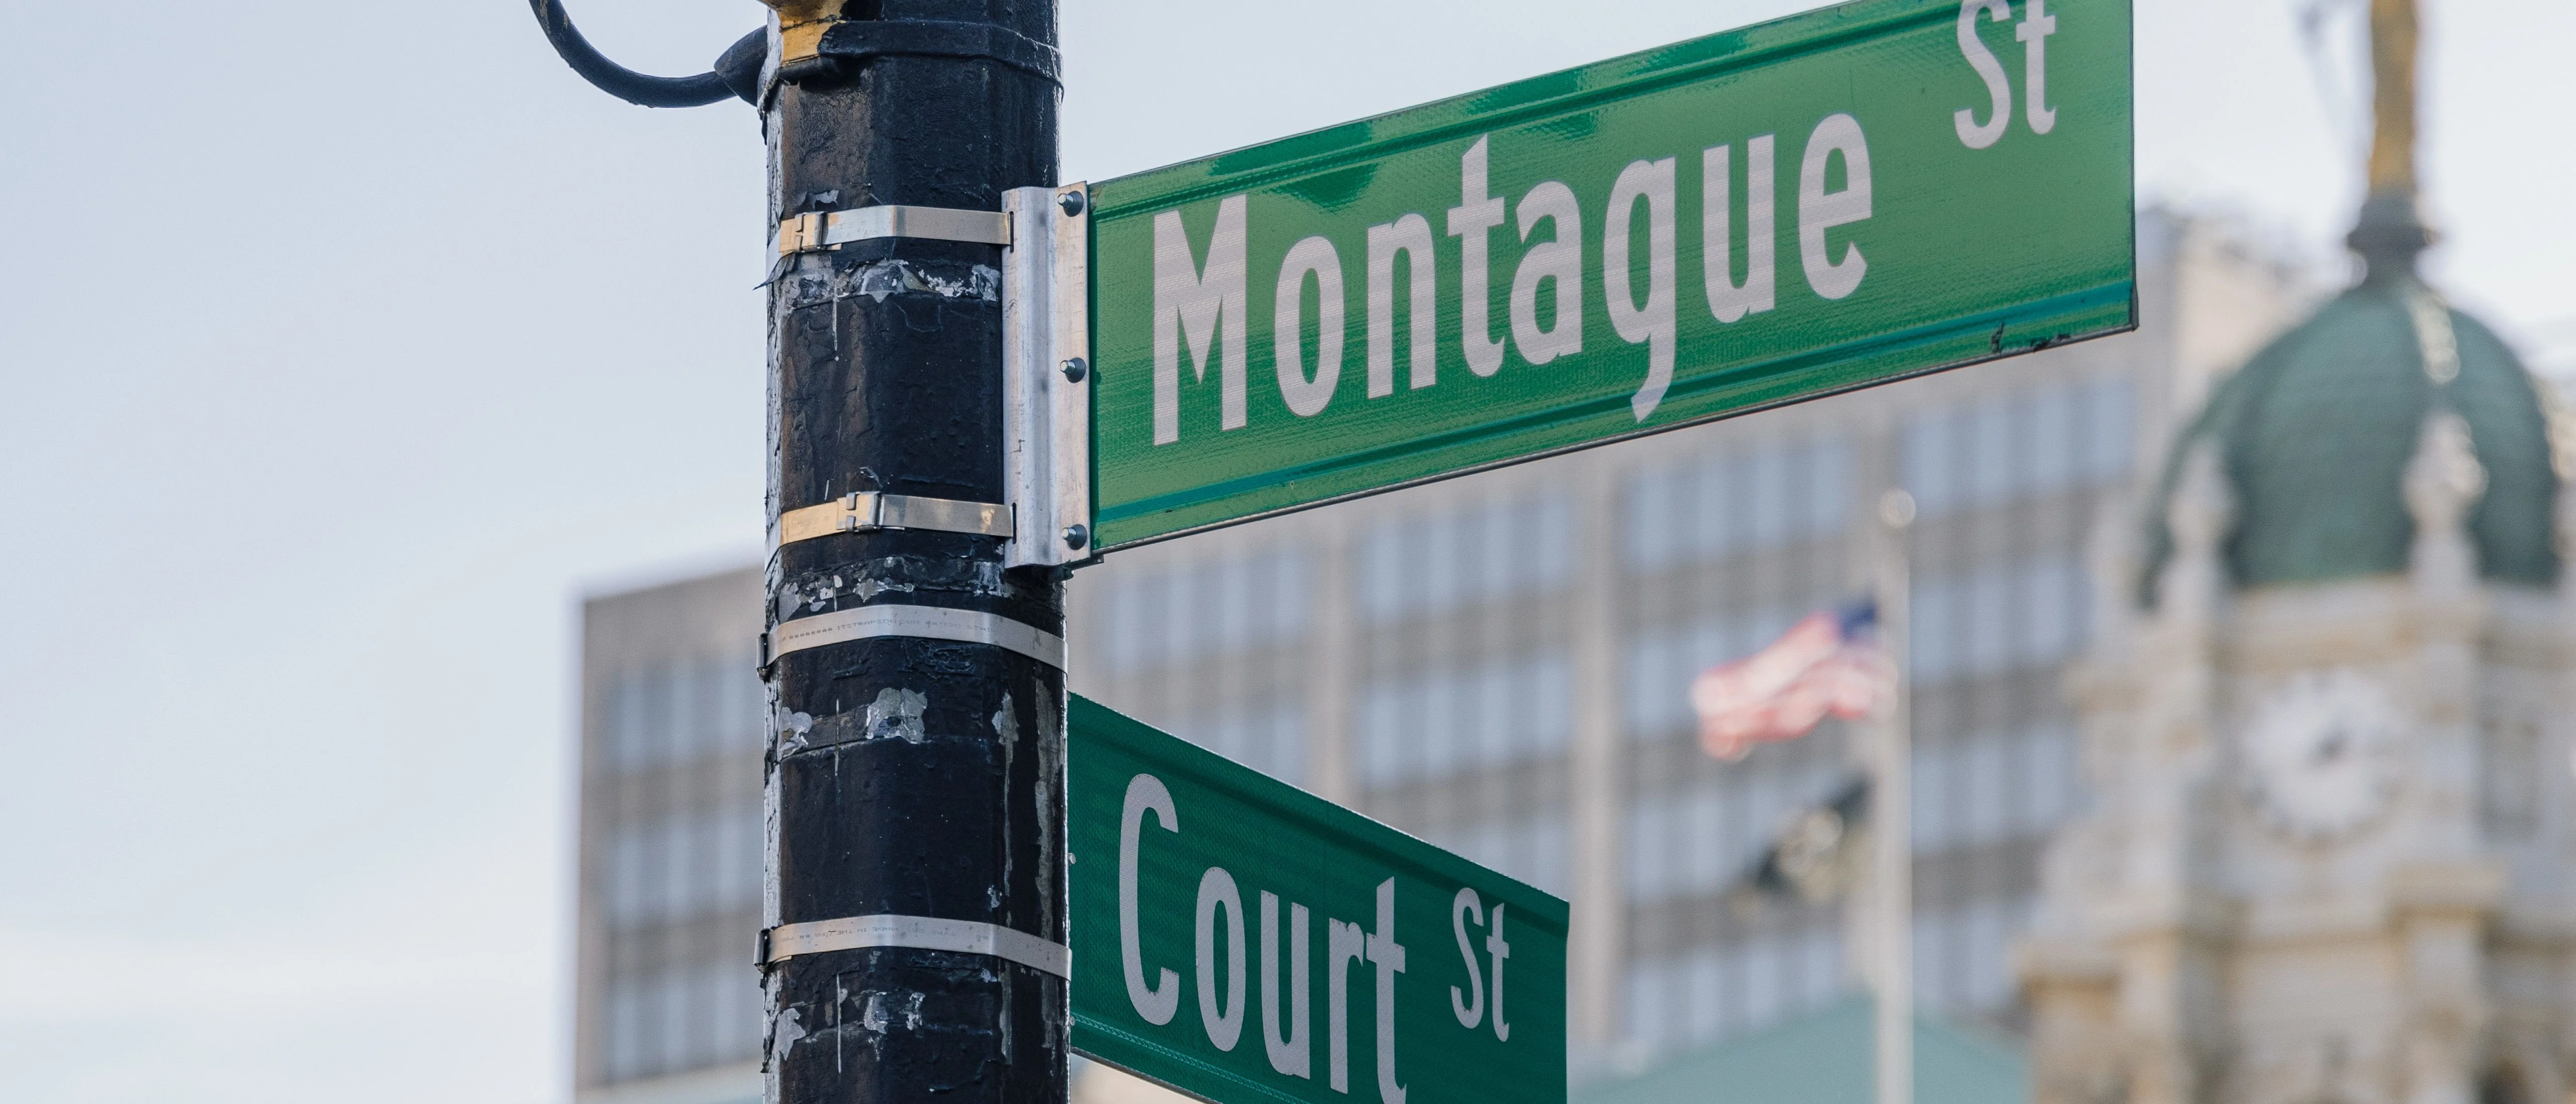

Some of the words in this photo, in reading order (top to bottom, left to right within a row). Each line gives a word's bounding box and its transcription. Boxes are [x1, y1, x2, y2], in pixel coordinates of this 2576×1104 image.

[1153, 113, 1872, 446] Montague
[1954, 0, 2056, 149] St
[1119, 773, 1407, 1104] Court
[1450, 887, 1510, 1042] St
